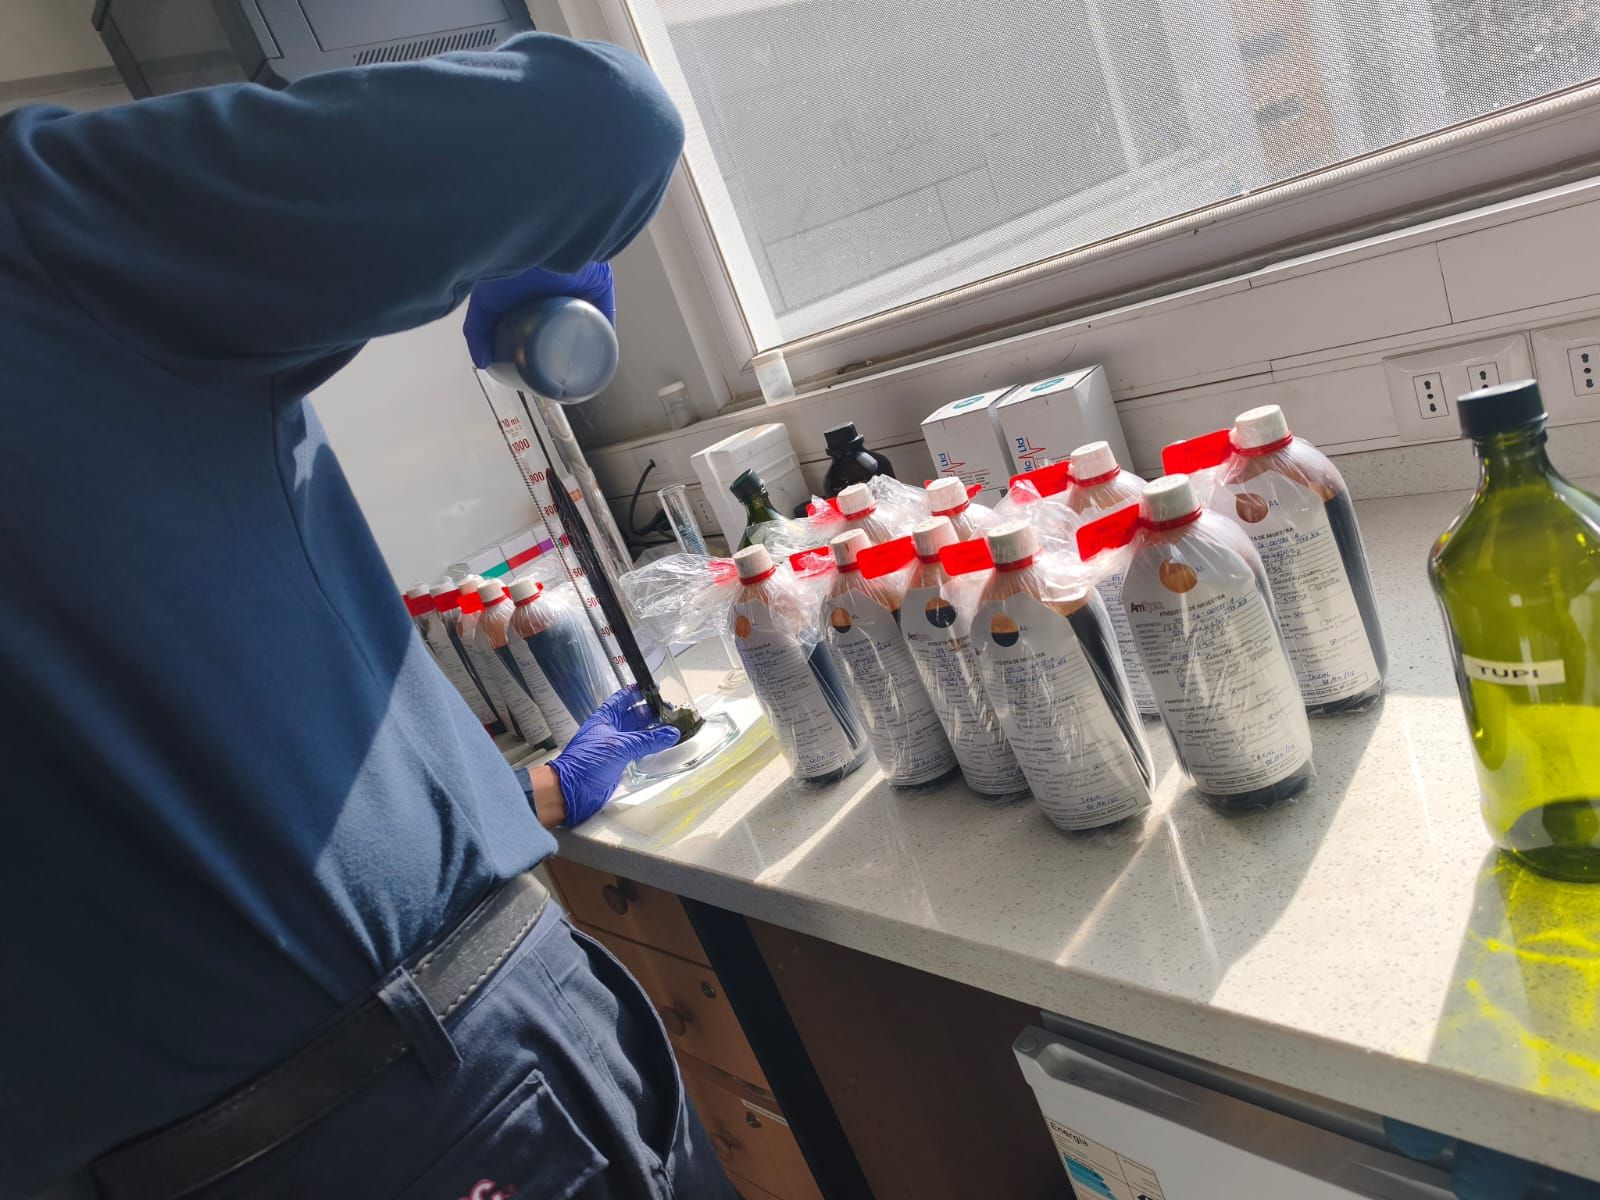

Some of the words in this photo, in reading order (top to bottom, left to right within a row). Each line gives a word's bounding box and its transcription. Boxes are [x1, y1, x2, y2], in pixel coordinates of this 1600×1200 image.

[512, 438, 530, 453] 1000
[1016, 437, 1028, 453] Ltd
[938, 453, 949, 467] Ltd
[1476, 665, 1540, 679] TUPI
